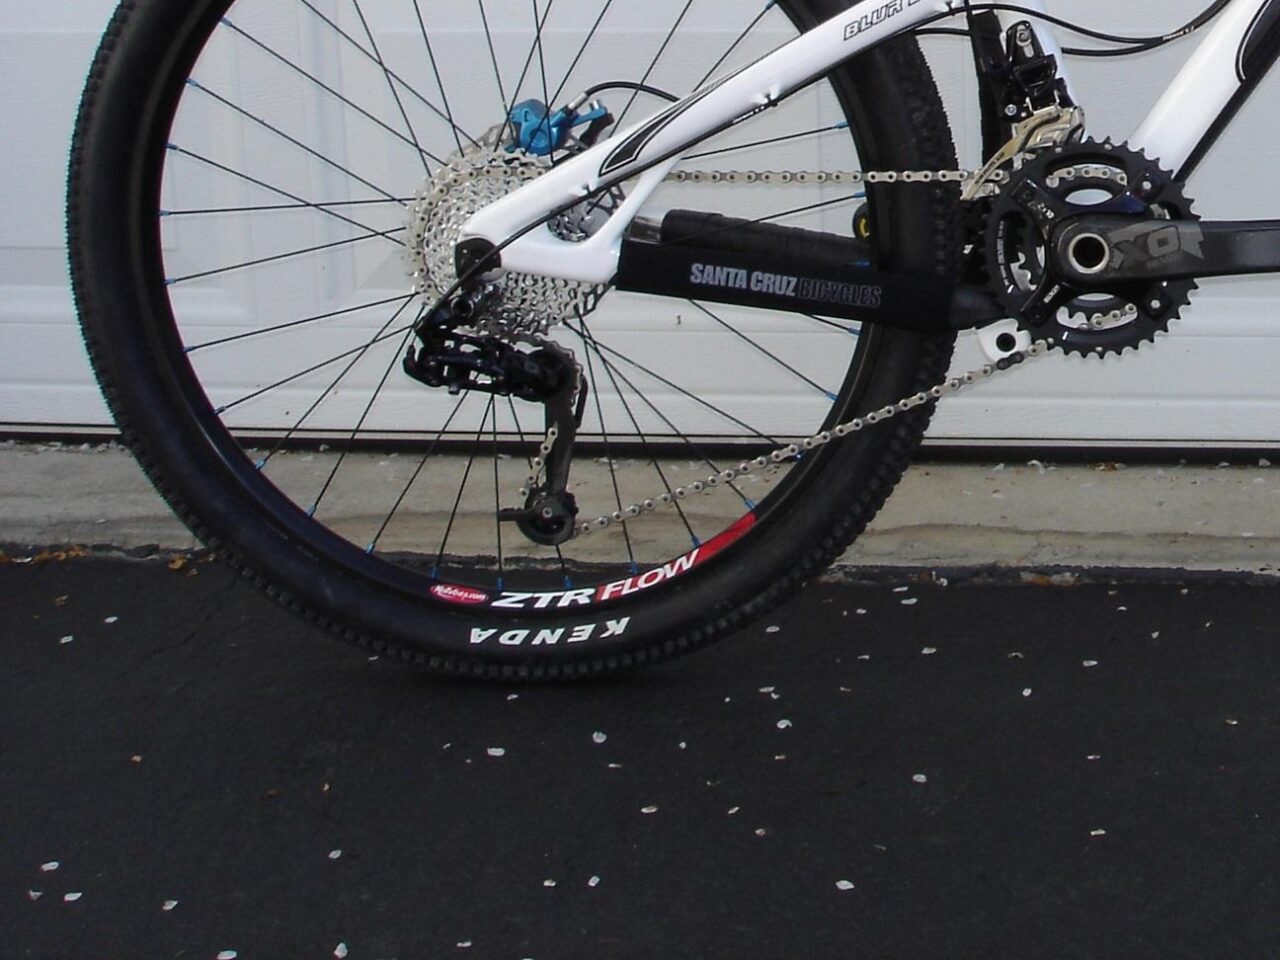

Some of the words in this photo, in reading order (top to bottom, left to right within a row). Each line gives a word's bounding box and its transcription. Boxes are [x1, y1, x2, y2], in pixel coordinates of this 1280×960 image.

[690, 262, 748, 289] SANTA
[750, 271, 798, 296] CRUZ
[798, 277, 883, 308] BICYCLES
[490, 587, 596, 608] ZTR
[600, 548, 700, 601] FLOW
[469, 616, 631, 646] KENDA
